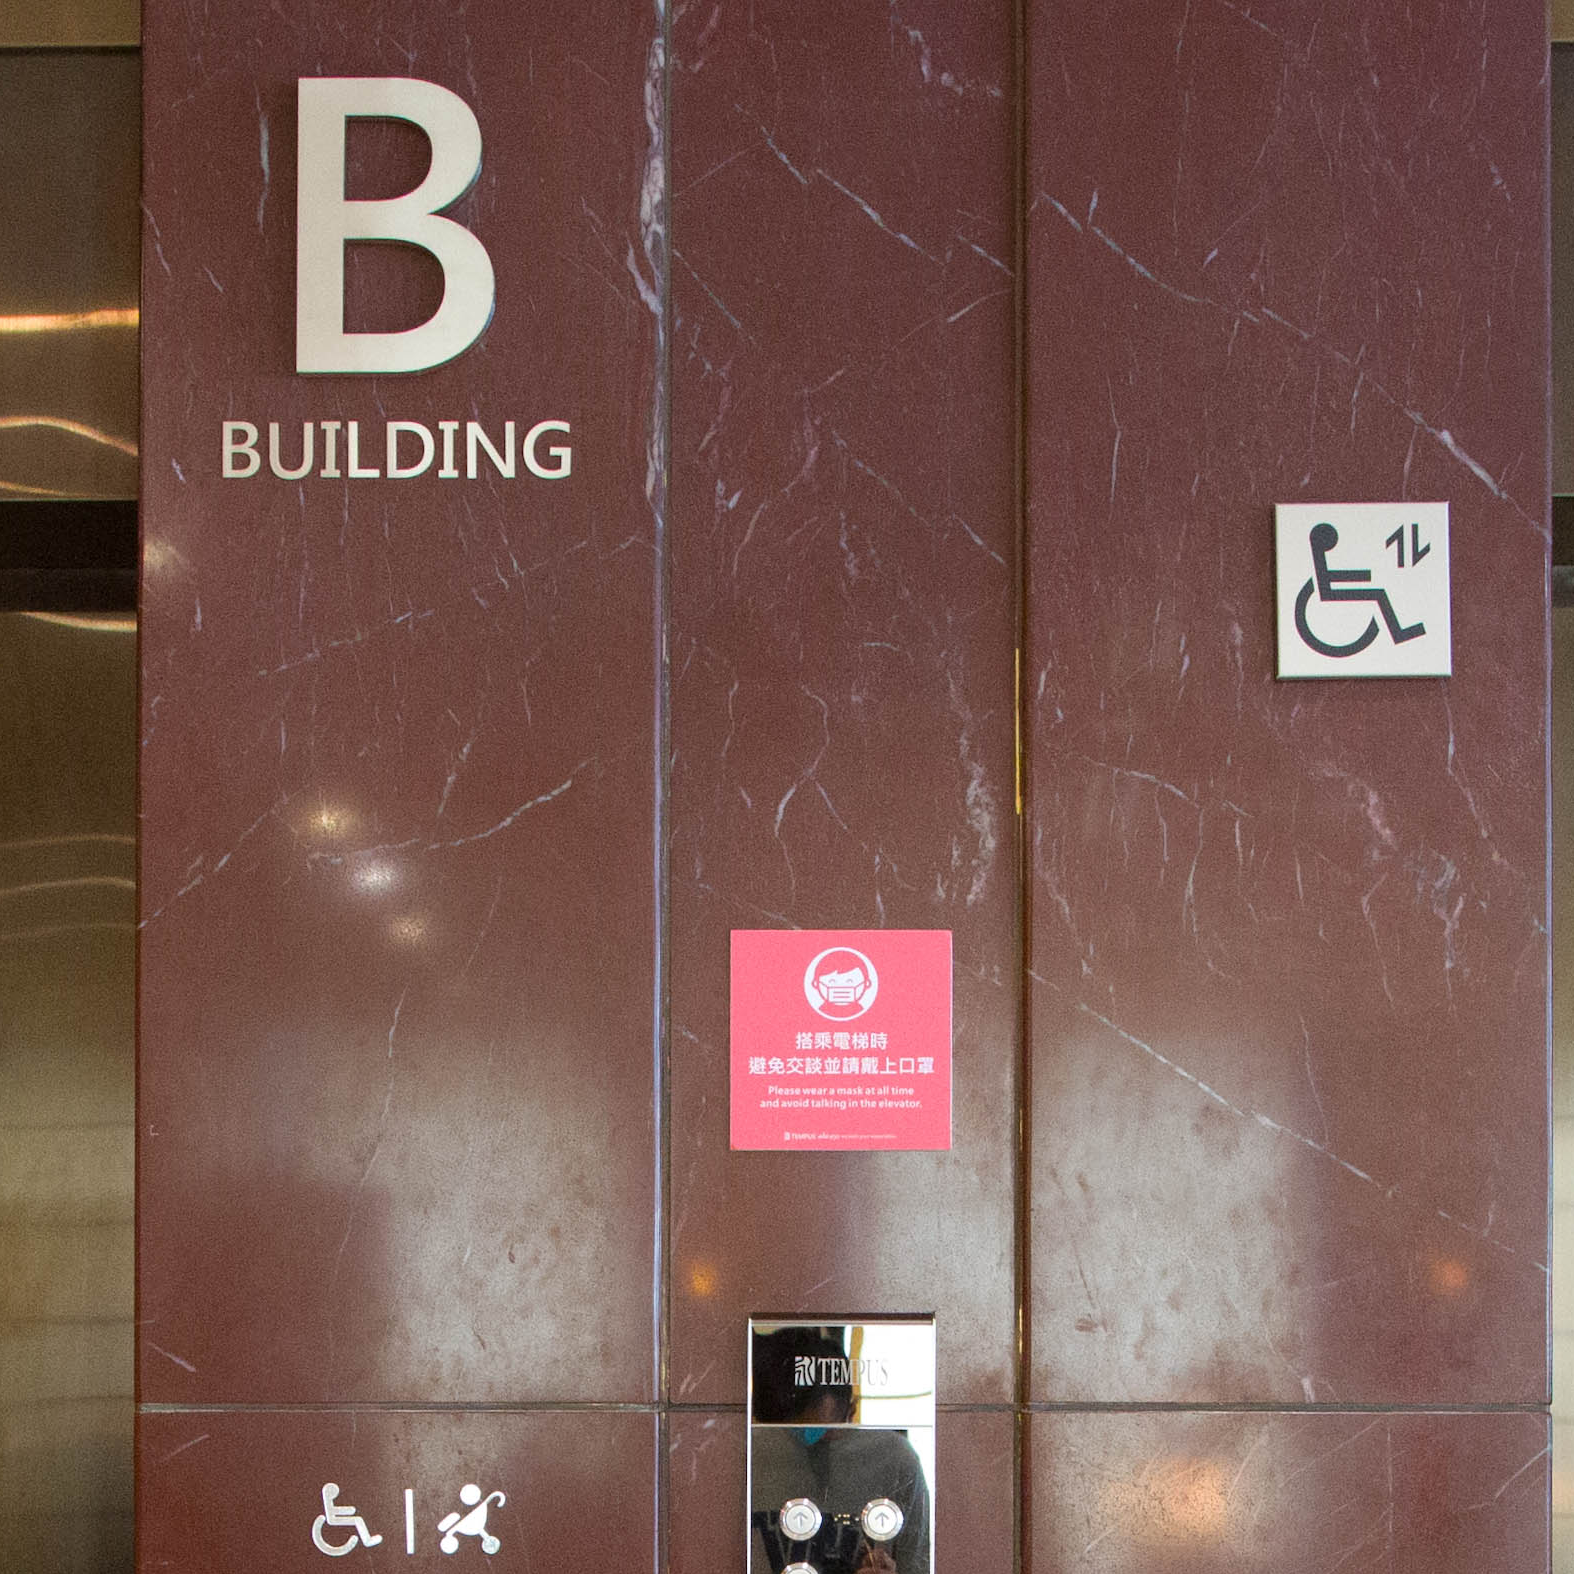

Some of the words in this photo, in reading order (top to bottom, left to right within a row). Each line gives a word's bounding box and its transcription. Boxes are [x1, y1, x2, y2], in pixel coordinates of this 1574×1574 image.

[296, 76, 496, 373] B
[221, 419, 573, 480] BUILDING
[795, 1031, 889, 1051] 搭乘電梯時
[748, 1056, 935, 1075] 避免交談並請戴上口罩
[768, 1085, 801, 1096] Please
[802, 1087, 827, 1096] wear
[837, 1085, 863, 1096] mask
[865, 1086, 875, 1096] at
[877, 1085, 889, 1096] all
[891, 1085, 915, 1096] time
[760, 1098, 780, 1109] and
[781, 1098, 809, 1109] avoid
[811, 1098, 847, 1110] talking
[848, 1098, 859, 1109] in
[860, 1098, 877, 1109] the
[878, 1098, 923, 1109] elevator.
